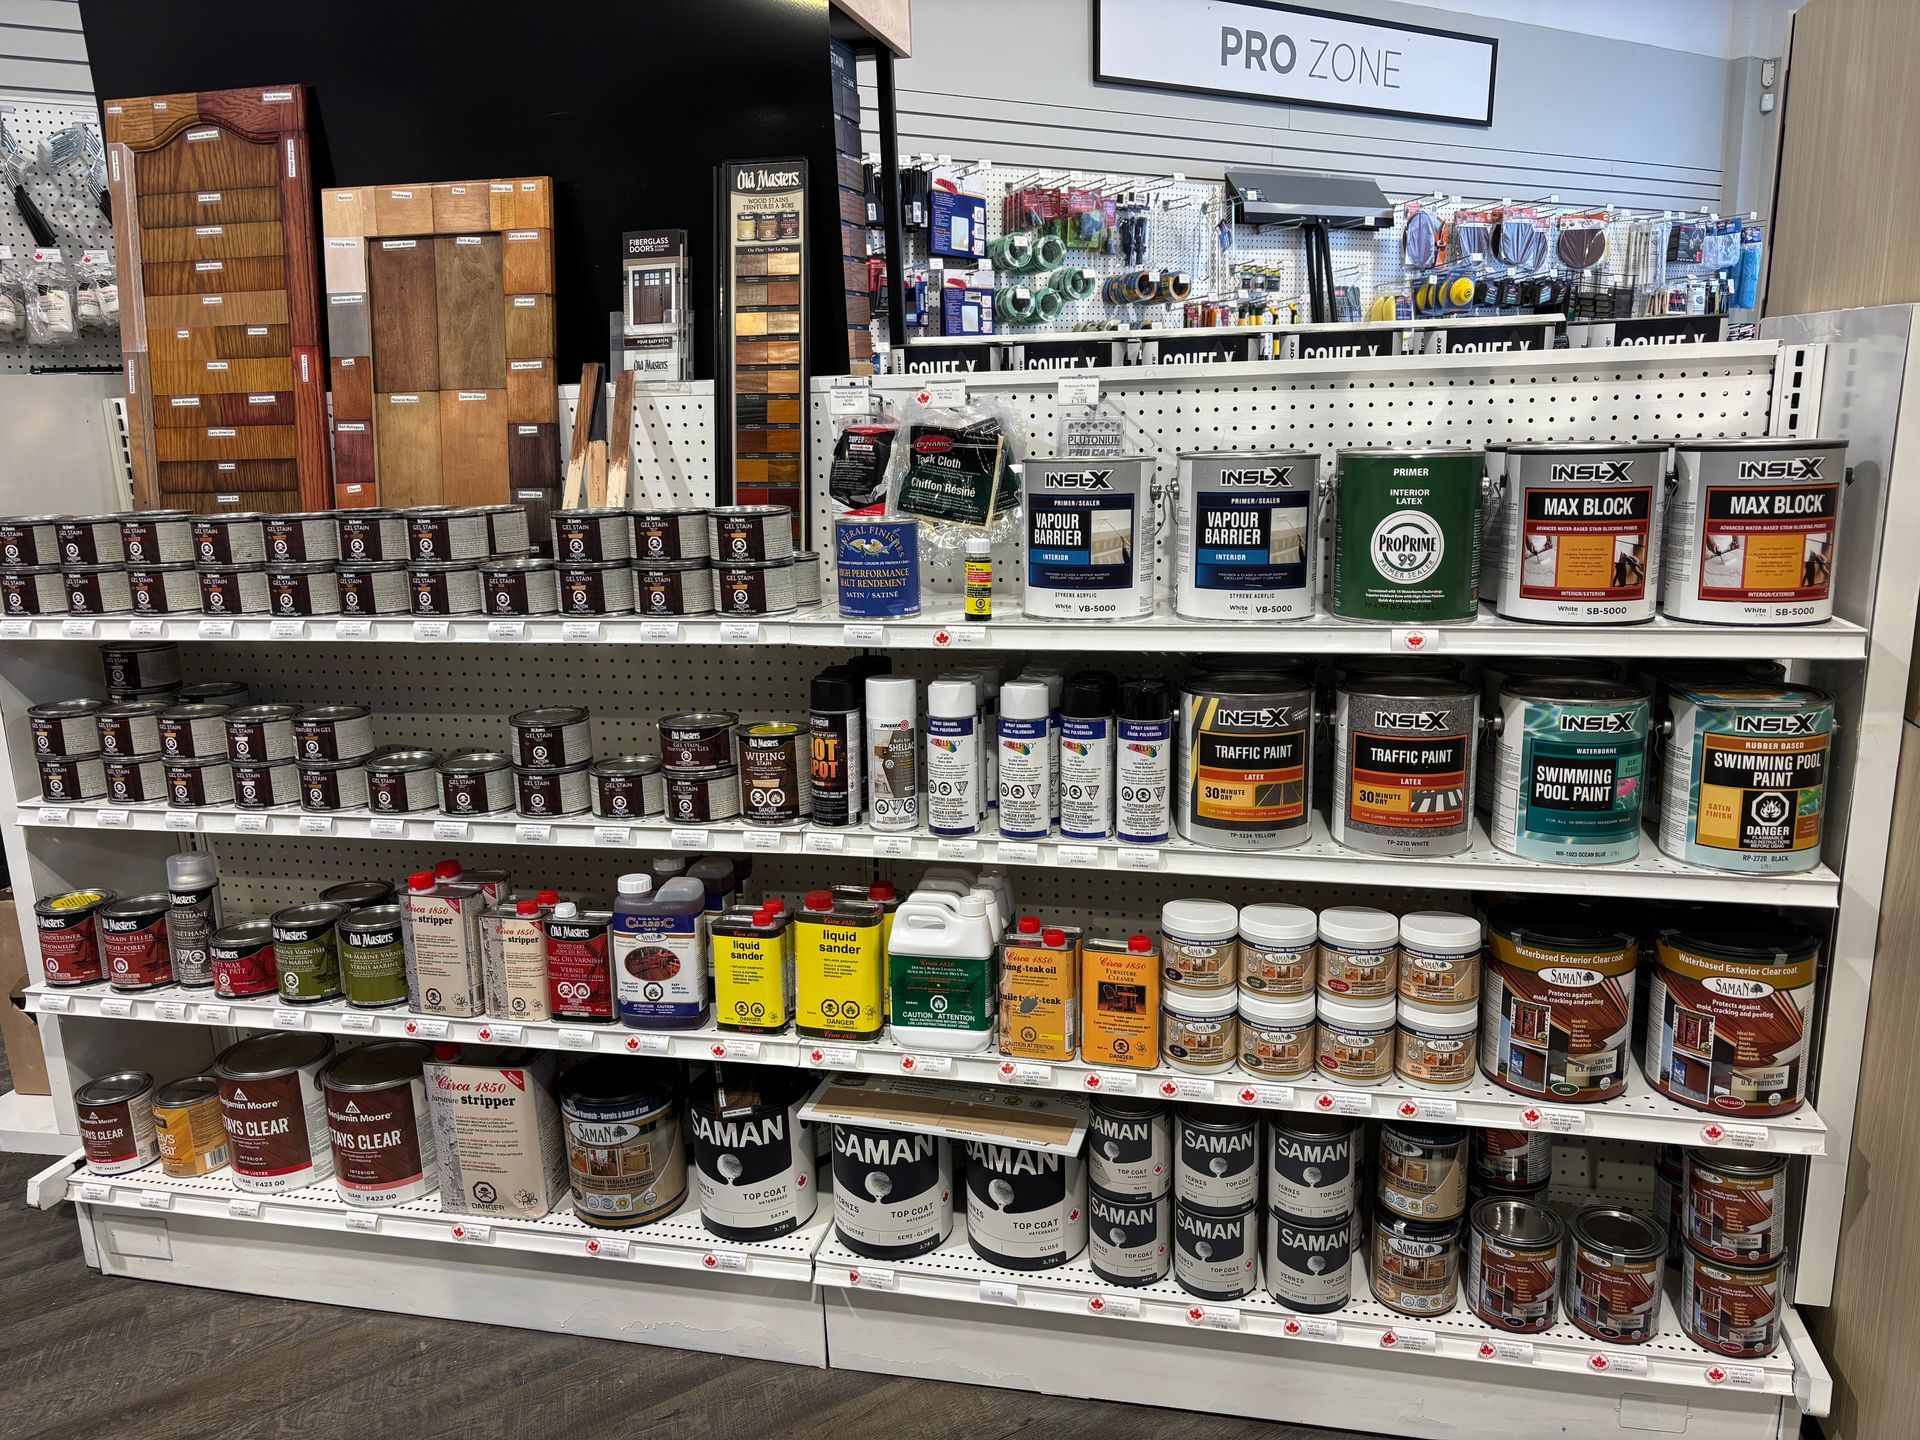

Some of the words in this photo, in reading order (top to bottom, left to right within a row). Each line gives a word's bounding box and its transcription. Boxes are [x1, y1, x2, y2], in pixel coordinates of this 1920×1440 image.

[1221, 26, 1297, 75] PRO
[1309, 39, 1402, 89] ZONE
[737, 170, 756, 190] Old
[756, 170, 800, 191] Masters
[742, 203, 775, 211] TEINTURES
[630, 237, 669, 247] FIBERGLASS
[630, 245, 655, 253] DOORS
[634, 360, 644, 372] Old
[644, 360, 668, 372] Masters
[916, 441, 951, 449] DYNAMIC
[1068, 435, 1121, 446] PLUTONIUM
[916, 455, 936, 465] Task
[938, 455, 962, 470] Cloth
[1737, 457, 1826, 482] INSL-X
[1220, 466, 1294, 489] INSL-X
[1393, 468, 1429, 477] PRIMER
[1551, 460, 1636, 484] INSL-X
[1045, 469, 1115, 490] INSL-X
[911, 477, 942, 493] Chiffon
[944, 483, 976, 498] Résiné
[1390, 489, 1430, 497] INTERIOR
[1544, 498, 1579, 516] MAX
[1582, 497, 1633, 516] BLOCK
[1730, 497, 1770, 515] MAX
[1774, 495, 1824, 514] BLOCK
[1035, 512, 1080, 529] VAPOUR
[1207, 510, 1259, 530] VAPOUR
[840, 526, 867, 558] GENERAL
[869, 526, 905, 558] FINISHES
[1034, 529, 1082, 546] BARRIER
[1204, 528, 1262, 546] BARRIER
[1398, 553, 1417, 567] 99
[852, 568, 910, 578] PERFORMANCE
[1380, 560, 1405, 578] PRIMER
[1408, 560, 1435, 579] SEALER
[857, 578, 907, 588] RENDEMENT
[872, 591, 899, 599] SATINÉ
[1256, 604, 1293, 614] VB-5000
[1587, 607, 1627, 615] SB-5000
[1775, 607, 1815, 616] SB-5000
[1218, 707, 1291, 728] INSL-X
[1375, 710, 1450, 731] INSL-X
[1560, 712, 1637, 735] INSL-X
[1735, 712, 1818, 735] INSL-X
[749, 739, 758, 748] Old
[758, 738, 779, 749] Masters
[888, 742, 915, 752] SHELLAC
[1745, 741, 1779, 750] RUBBER
[1781, 742, 1805, 750] BASED
[744, 751, 786, 761] WIPING
[1215, 745, 1261, 760] TRAFFIC
[1263, 744, 1292, 759] PAINT
[1371, 748, 1419, 764] TRAFFIC
[1422, 749, 1453, 764] PAINT
[1714, 752, 1794, 771] SWIMMING
[1796, 751, 1822, 769] POOL
[1244, 773, 1265, 781] LATEX
[1536, 765, 1612, 785] SWIMMING
[1753, 772, 1794, 787] PAINT
[1205, 786, 1220, 800] 30
[1220, 788, 1246, 796] MINUTE
[1536, 783, 1570, 801] POOL
[1573, 786, 1612, 802] PAINT
[1708, 803, 1731, 812] SATIN
[1706, 810, 1732, 820] FINISH
[1747, 826, 1790, 836] DANGER
[403, 901, 425, 915] Circa
[426, 906, 449, 915] 1850
[418, 915, 454, 926] stripper
[625, 917, 675, 929] CLASSIC
[550, 927, 561, 938] Old
[562, 926, 590, 938] Masters
[823, 930, 857, 943] liquid
[819, 943, 861, 955] sander
[1515, 946, 1559, 963] Waterbased
[1560, 952, 1592, 965] Exterior
[1593, 954, 1607, 963] Clear
[1608, 953, 1624, 962] coat
[1100, 956, 1124, 968] Circa
[1127, 961, 1147, 970] 1850
[1272, 953, 1291, 963] SAMAN
[1106, 968, 1138, 977] FURNITURE
[1550, 970, 1583, 985] SAMAN
[1548, 989, 1570, 999] Protects
[1571, 992, 1593, 1000] against
[1715, 979, 1750, 996] SAMAN
[1532, 994, 1548, 1003] mold,
[1549, 996, 1572, 1006] cracking
[1584, 999, 1604, 1007] peeling
[902, 1011, 933, 1020] CAUTION
[937, 1013, 976, 1023] ATTENTION
[436, 1074, 471, 1093] Circa
[474, 1082, 507, 1094] 1850
[461, 1095, 516, 1109] stripper
[328, 1108, 358, 1123] Benjamin
[360, 1113, 391, 1122] Moore
[578, 1123, 612, 1143] SAMAN
[691, 1109, 784, 1148] SAMAN
[329, 1127, 355, 1150] STAYS
[358, 1130, 402, 1150] CLEAR
[834, 1124, 933, 1165] SAMAN
[1185, 1129, 1253, 1154] SAMAN
[1278, 1137, 1348, 1163] SAMAN
[742, 1192, 762, 1200] TOP
[763, 1186, 788, 1199] COAT
[770, 1209, 789, 1220] SATIN
[1091, 1197, 1154, 1226] SAMAN
[1013, 1222, 1032, 1230] TOP
[1034, 1219, 1059, 1229] COAT
[897, 1227, 934, 1241] SEMI-GLOSS
[1281, 1228, 1349, 1252] SAMAN
